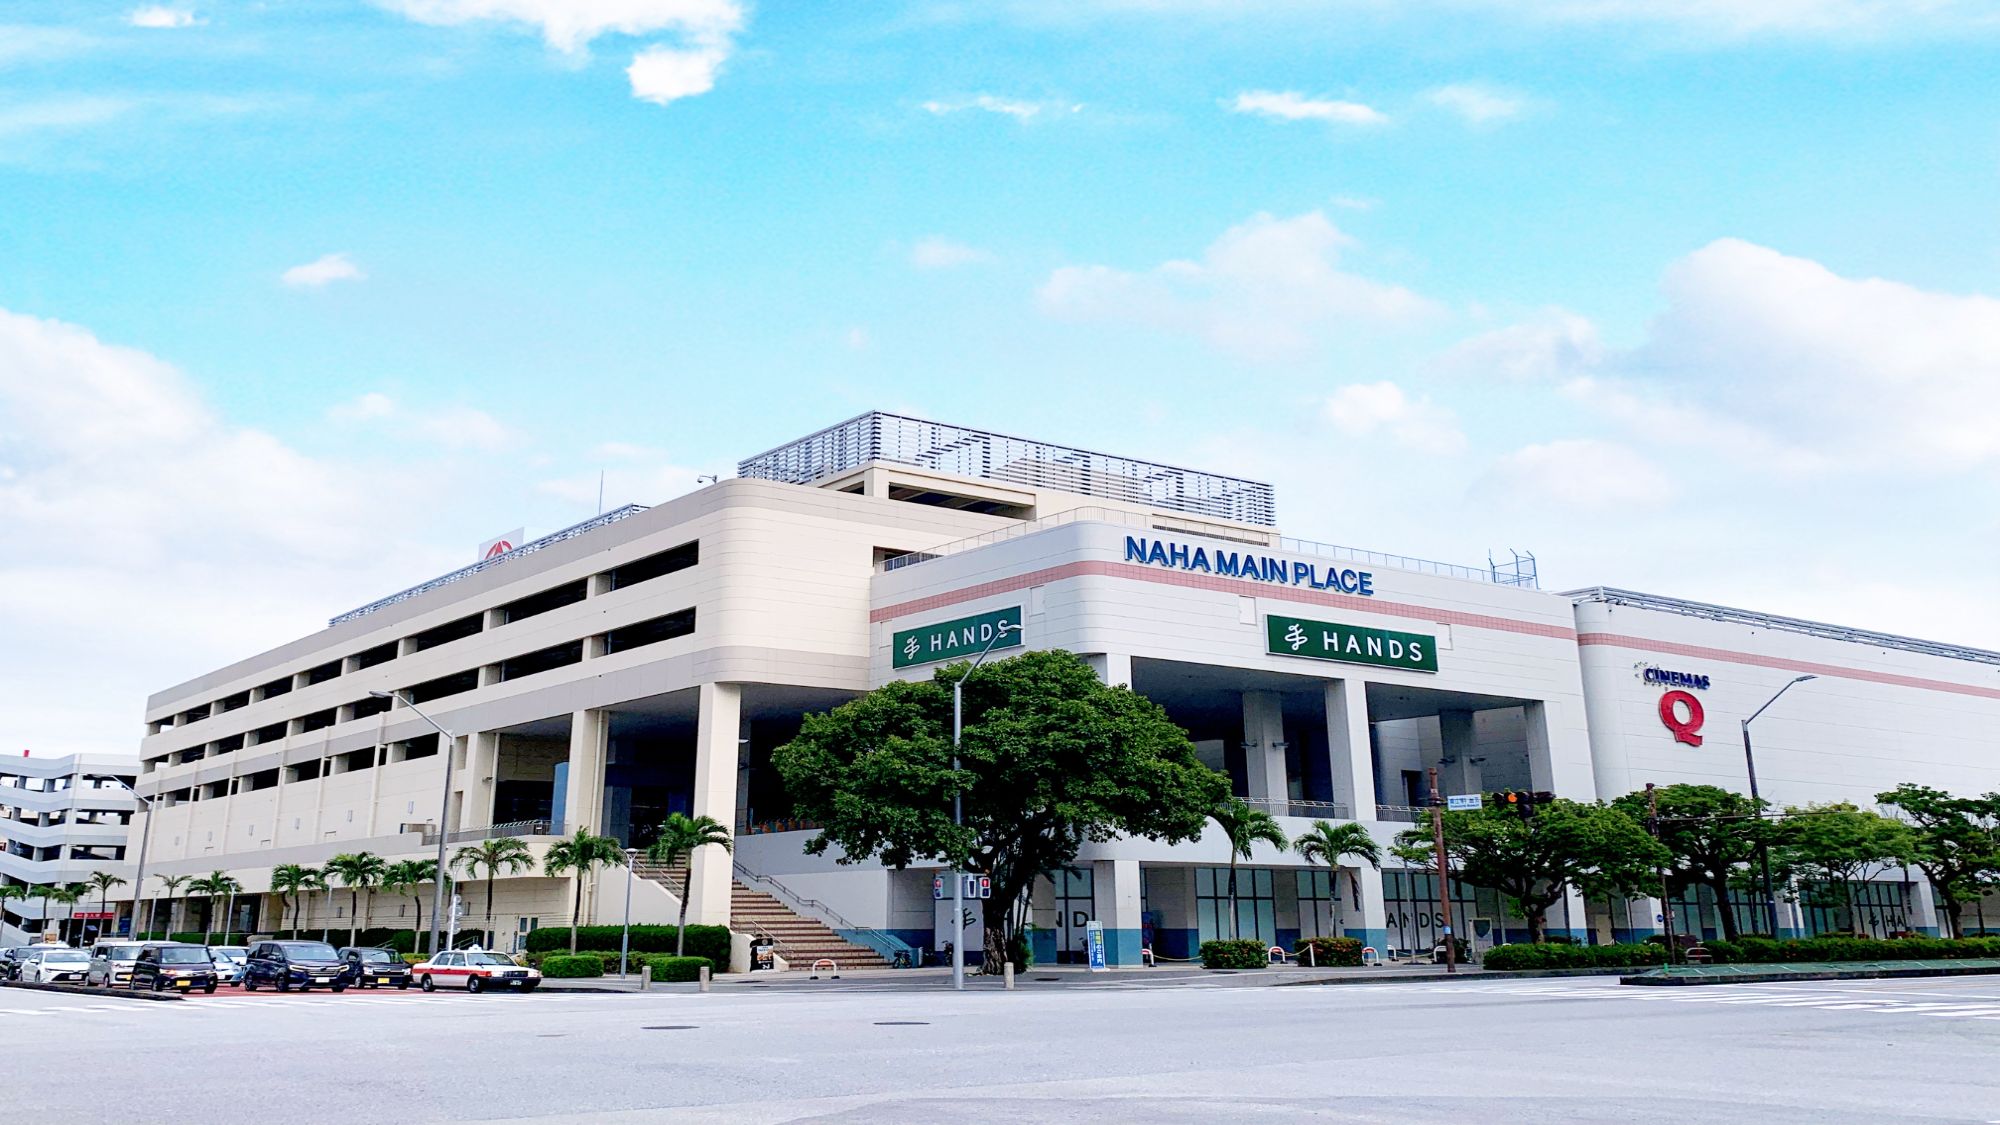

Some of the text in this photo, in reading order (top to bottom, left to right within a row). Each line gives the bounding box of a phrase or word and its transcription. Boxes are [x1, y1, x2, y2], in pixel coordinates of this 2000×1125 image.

[1125, 536, 1374, 595] NAHA MAIN PLACE
[930, 619, 1008, 652] HANDS
[1323, 631, 1423, 662] HANDS
[1643, 668, 1710, 690] CINEMAS
[1658, 690, 1705, 747] Q
